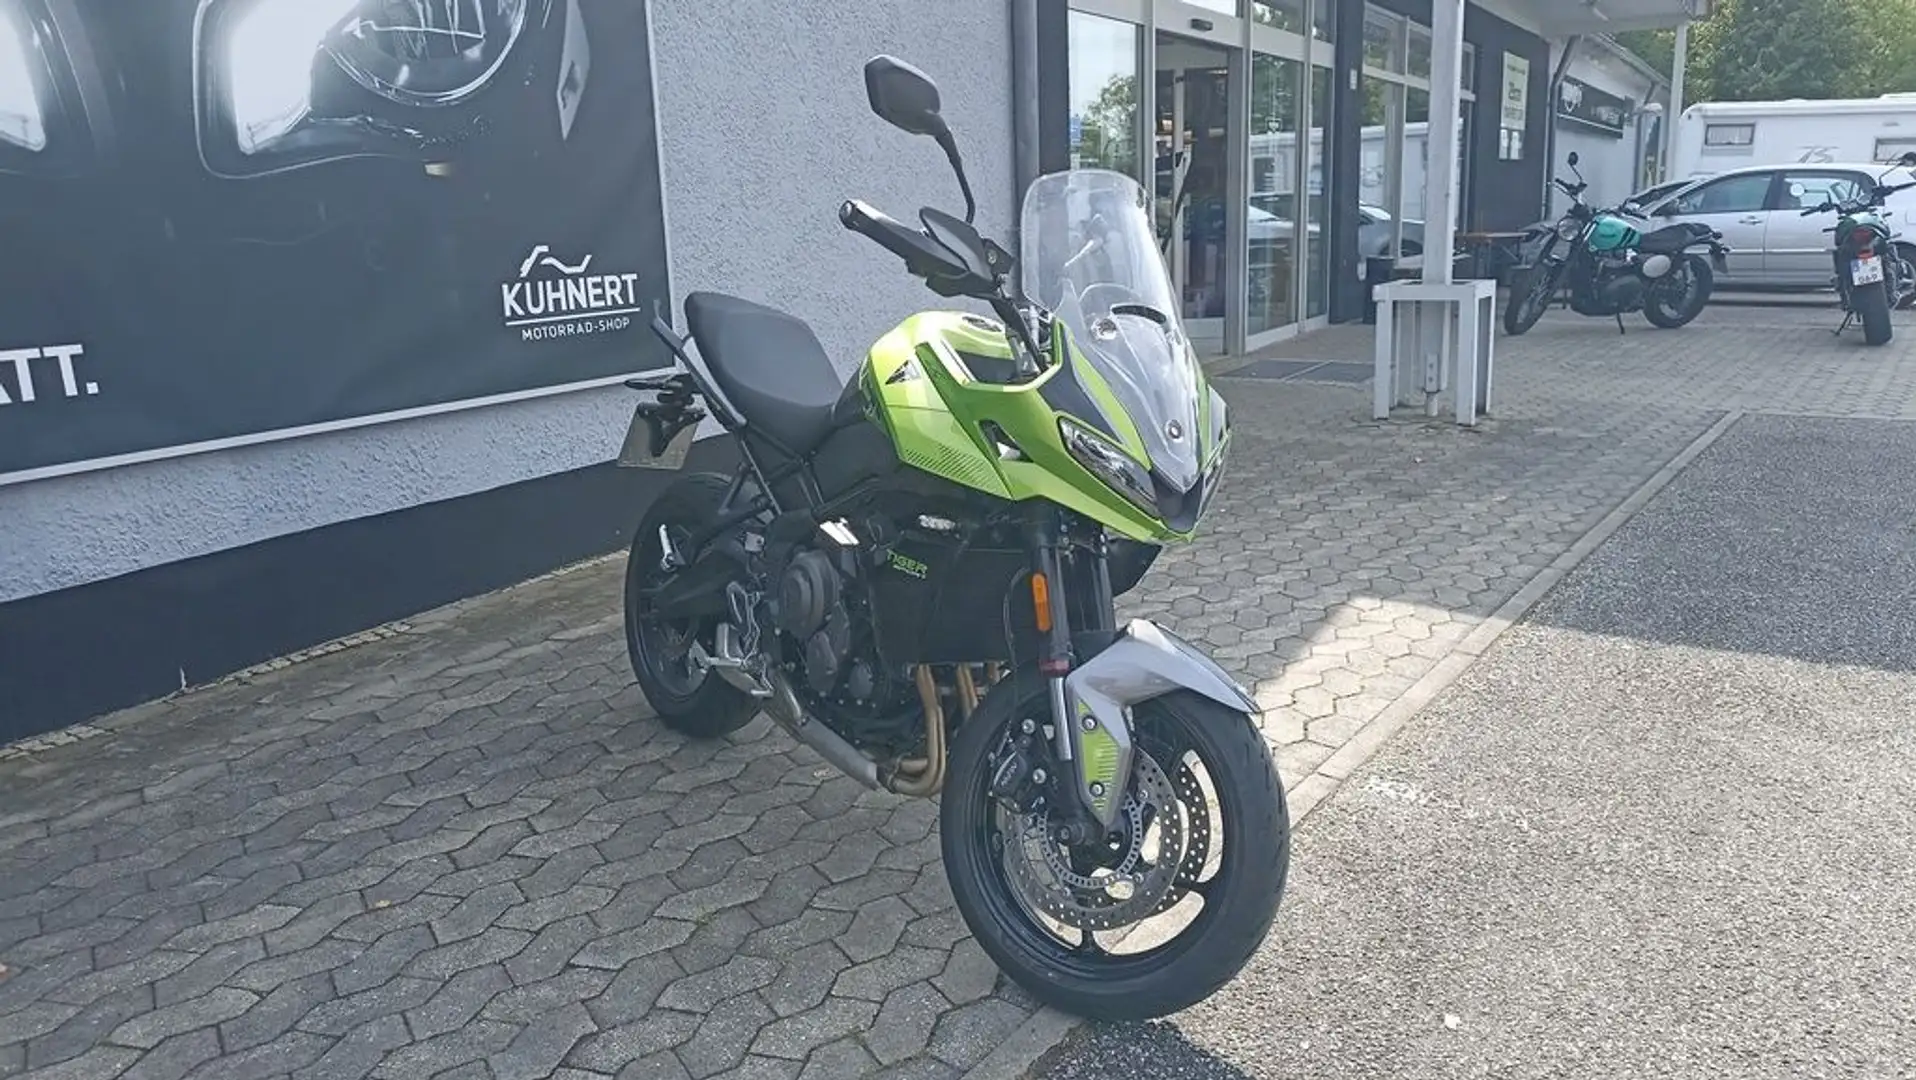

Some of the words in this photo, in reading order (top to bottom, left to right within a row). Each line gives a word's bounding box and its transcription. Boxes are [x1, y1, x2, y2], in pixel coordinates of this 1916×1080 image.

[501, 273, 638, 317] KUHNERT
[521, 316, 630, 341] MOTORRAD-SHOP
[0, 344, 99, 405] TT.
[886, 548, 928, 574] TIGER
